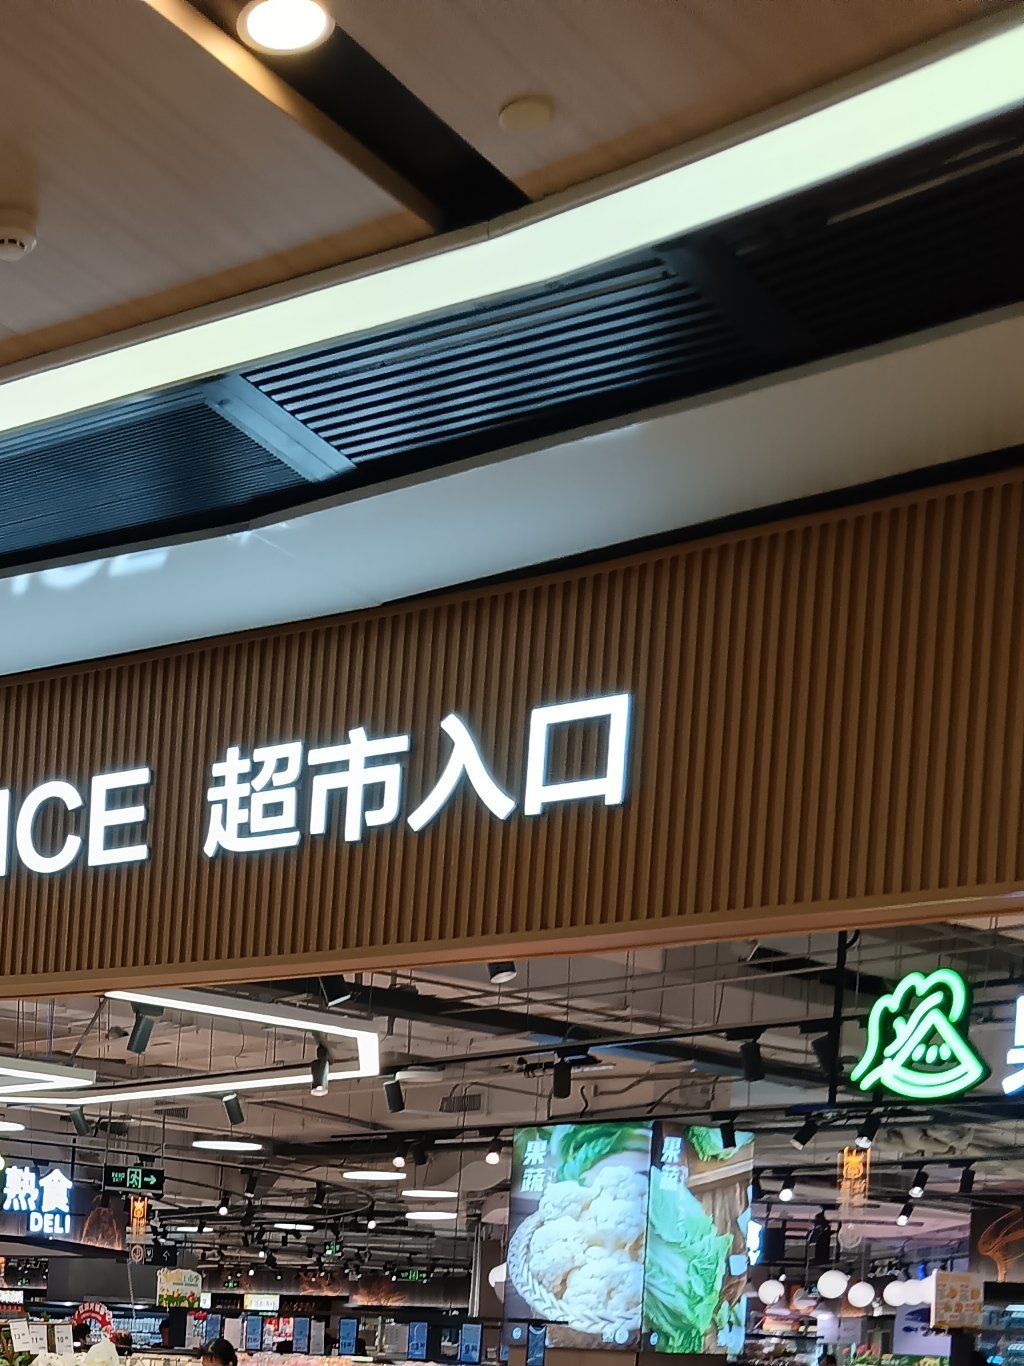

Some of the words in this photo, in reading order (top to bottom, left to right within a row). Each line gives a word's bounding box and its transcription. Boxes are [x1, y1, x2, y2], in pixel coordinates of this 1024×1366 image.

[203, 693, 632, 858] 超市入口
[3, 1165, 73, 1213] 熟食
[520, 1139, 549, 1193] 果蔬
[660, 1136, 685, 1191] 果蔬
[29, 1211, 72, 1234] DELI
